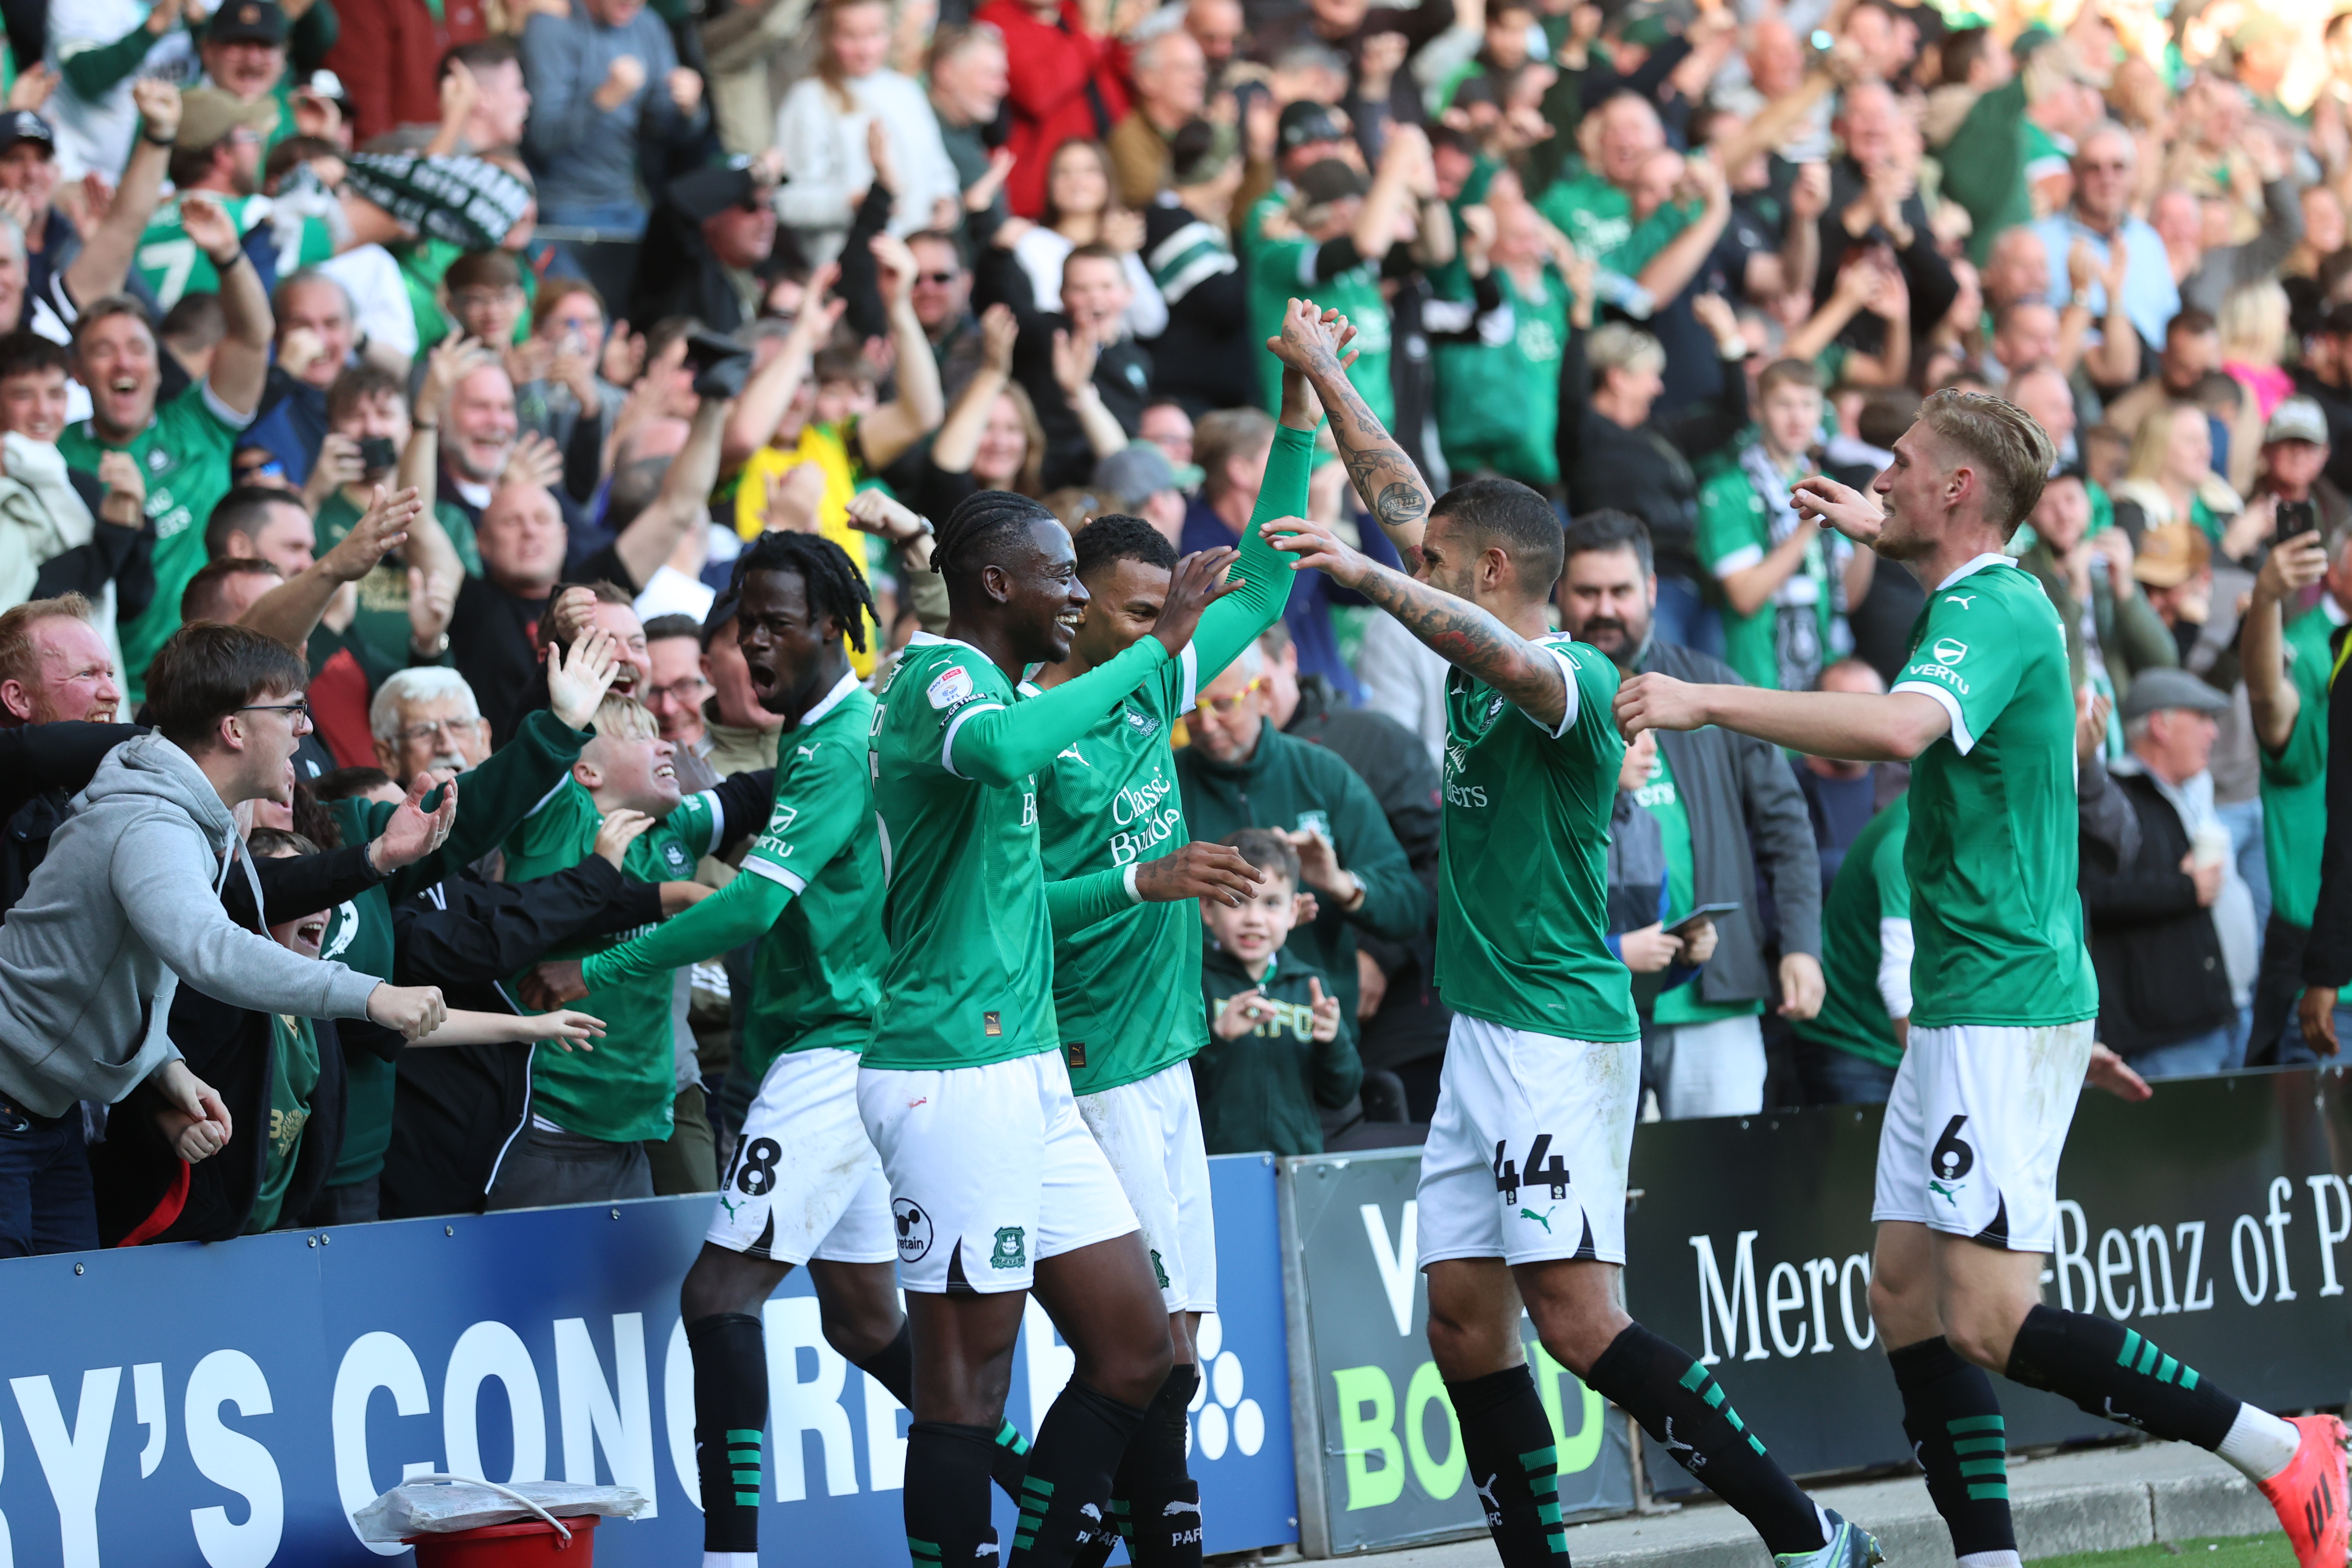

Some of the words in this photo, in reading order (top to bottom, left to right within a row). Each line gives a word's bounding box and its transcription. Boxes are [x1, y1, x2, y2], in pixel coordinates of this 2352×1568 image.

[930, 679, 941, 693] sky
[943, 670, 960, 679] bet
[946, 693, 961, 702] EFL
[1910, 663, 1969, 695] VERTU
[723, 1134, 782, 1196] 18
[1494, 1134, 1570, 1206] 44
[1931, 1115, 1974, 1180] 6
[2232, 1176, 2297, 1306] of
[2305, 1173, 2352, 1298] P
[0, 1348, 284, 1568] Y'S
[1332, 1339, 1605, 1512] BOD
